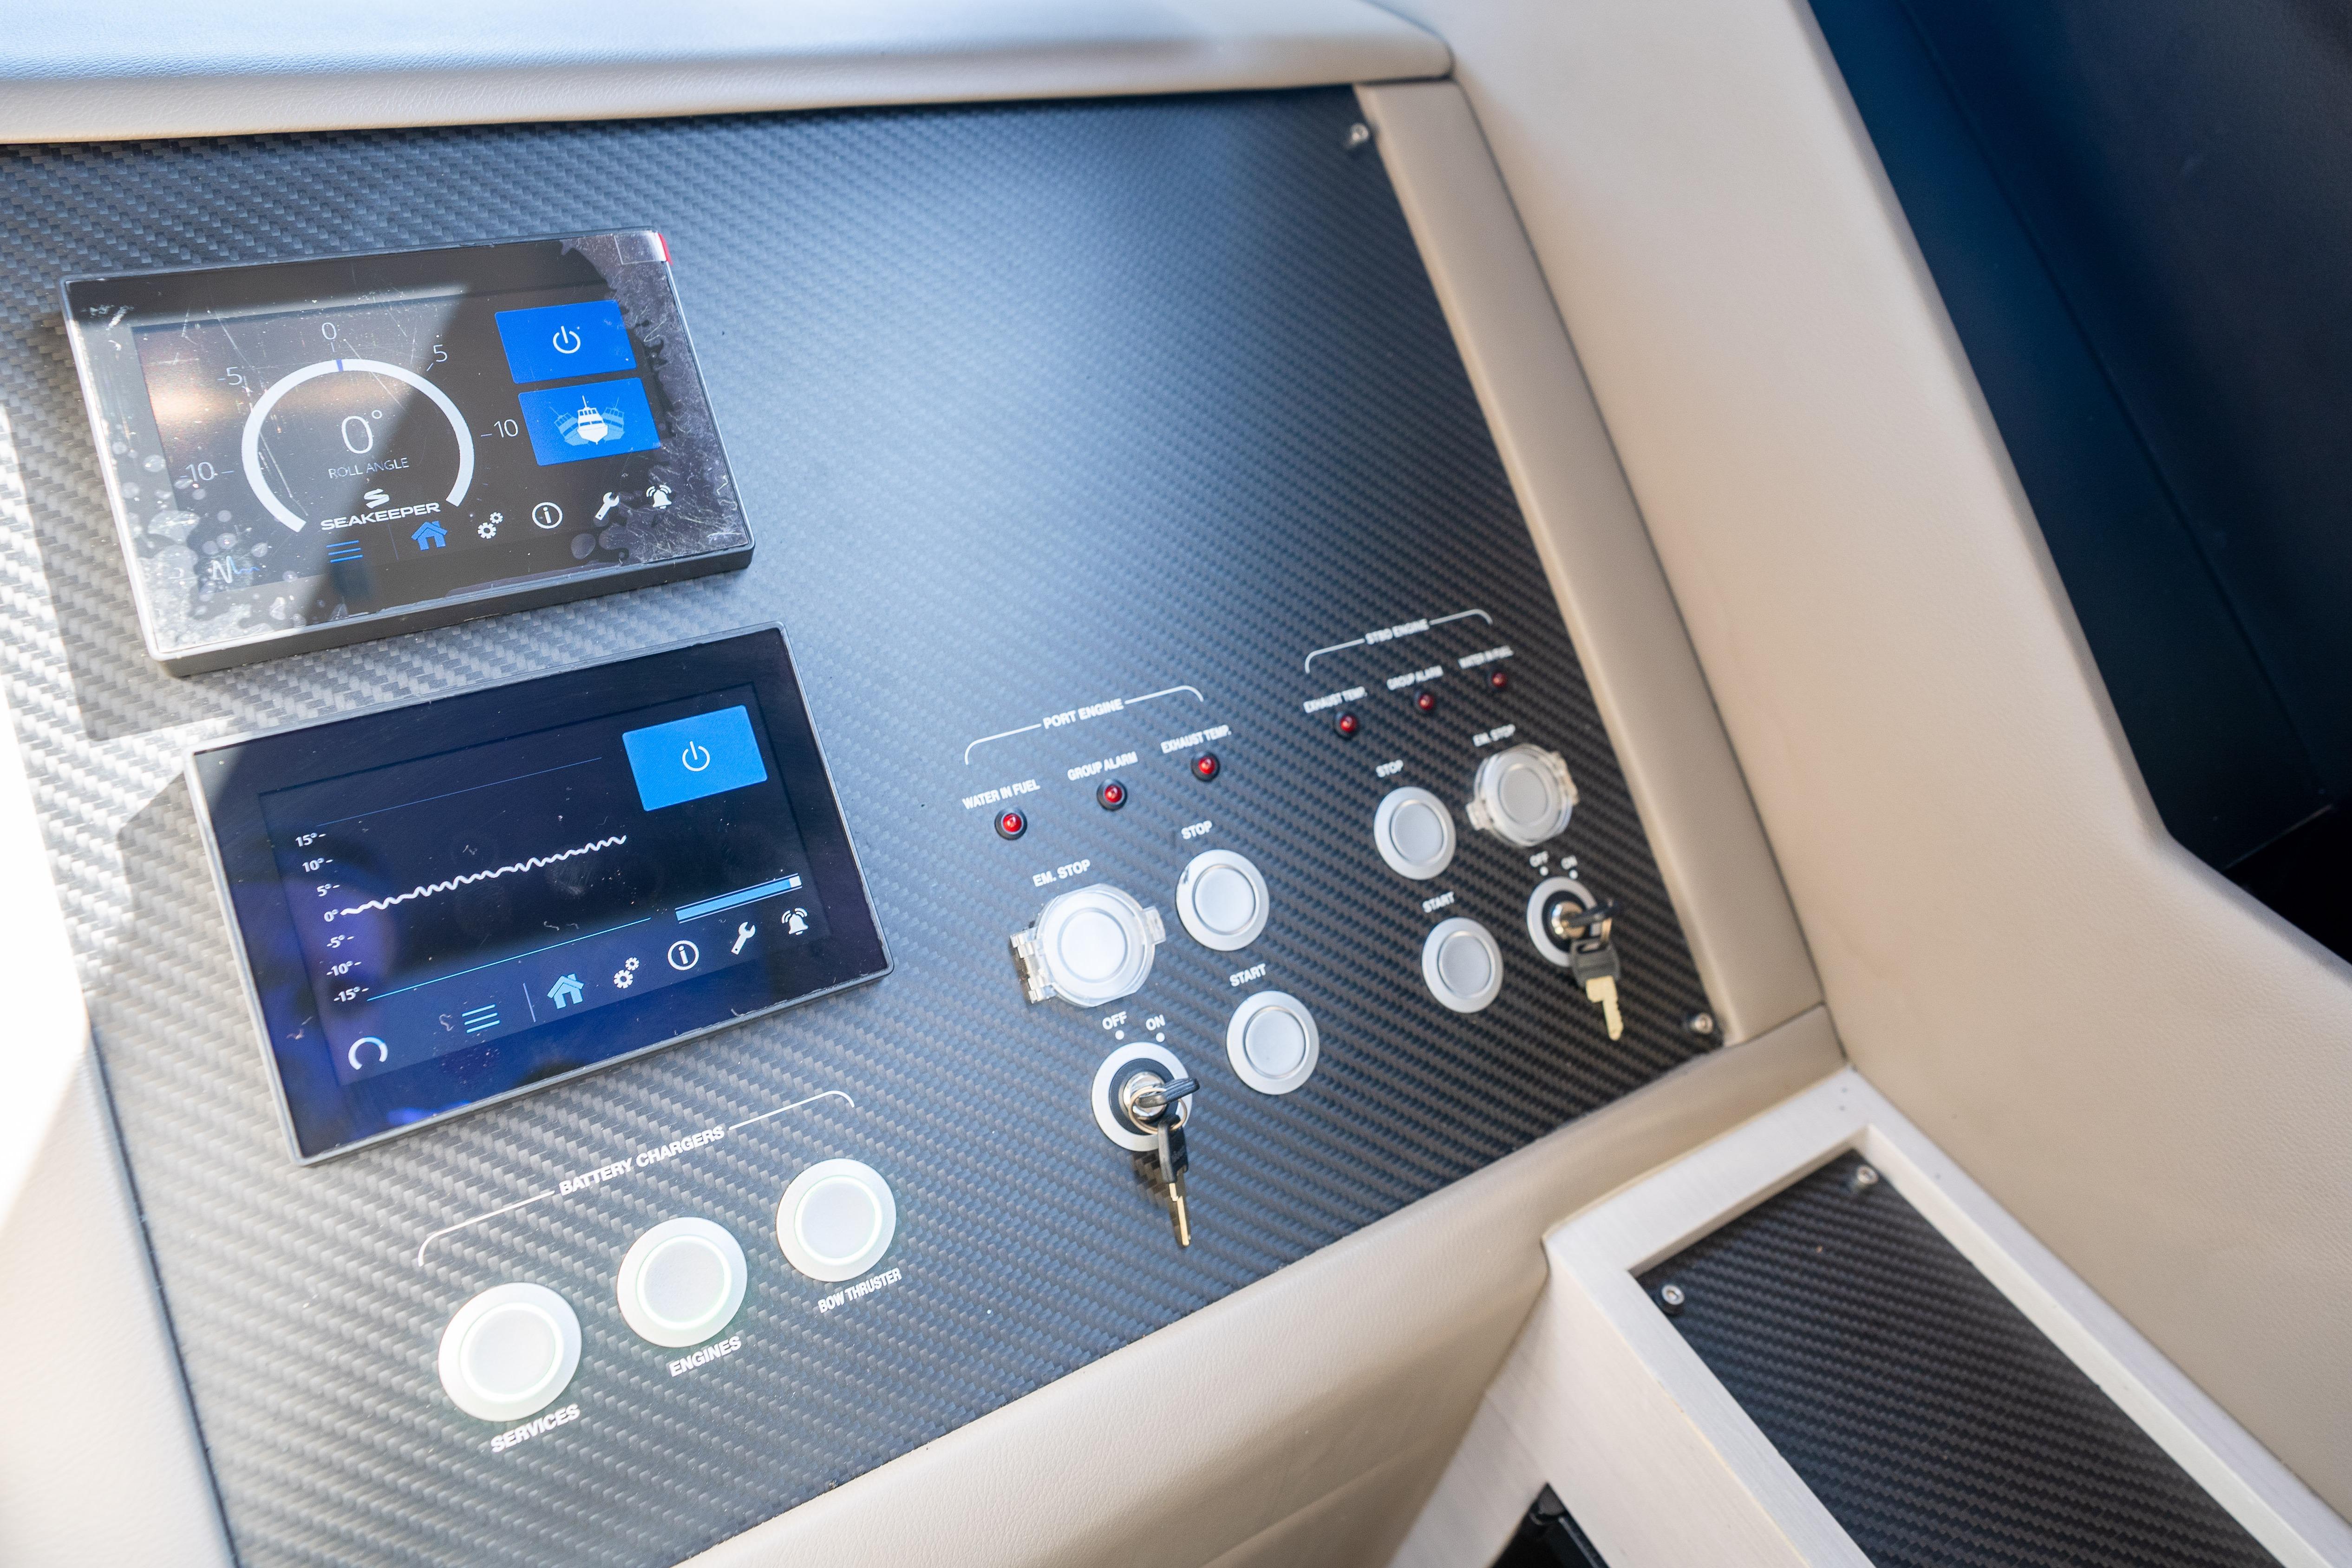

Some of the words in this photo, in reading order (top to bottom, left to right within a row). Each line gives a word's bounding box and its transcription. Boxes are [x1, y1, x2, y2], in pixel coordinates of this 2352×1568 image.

[321, 322, 337, 340] 0
[433, 344, 448, 362] 5
[341, 410, 382, 454] 0°
[493, 419, 519, 438] 10
[328, 465, 363, 478] ROLL
[366, 457, 409, 473] ANGLE
[320, 502, 441, 530] SEAKEEPER
[1043, 710, 1076, 729] PORT
[1078, 698, 1124, 721] ENGINE
[1161, 732, 1202, 753] EXHAUST
[1067, 760, 1102, 781] GROUP
[1104, 751, 1138, 771] ALARM
[1376, 759, 1404, 778] STOP
[962, 791, 999, 809] WATER
[1000, 787, 1012, 799] IN
[1012, 779, 1040, 796] FUEL
[1181, 820, 1212, 839] STOP
[1032, 871, 1056, 887] EM.
[1057, 859, 1091, 879] STOP
[1422, 891, 1454, 913] START
[1229, 964, 1267, 987] START
[1102, 1012, 1127, 1031] OFF
[1145, 1014, 1165, 1031] ON
[558, 1158, 633, 1197] BATTERY
[635, 1125, 725, 1168] CHARGERS
[817, 1287, 845, 1313] BOW
[844, 1268, 902, 1302] THRUSTER
[669, 1335, 741, 1377] ENGINES
[490, 1404, 580, 1453] SERVICES
